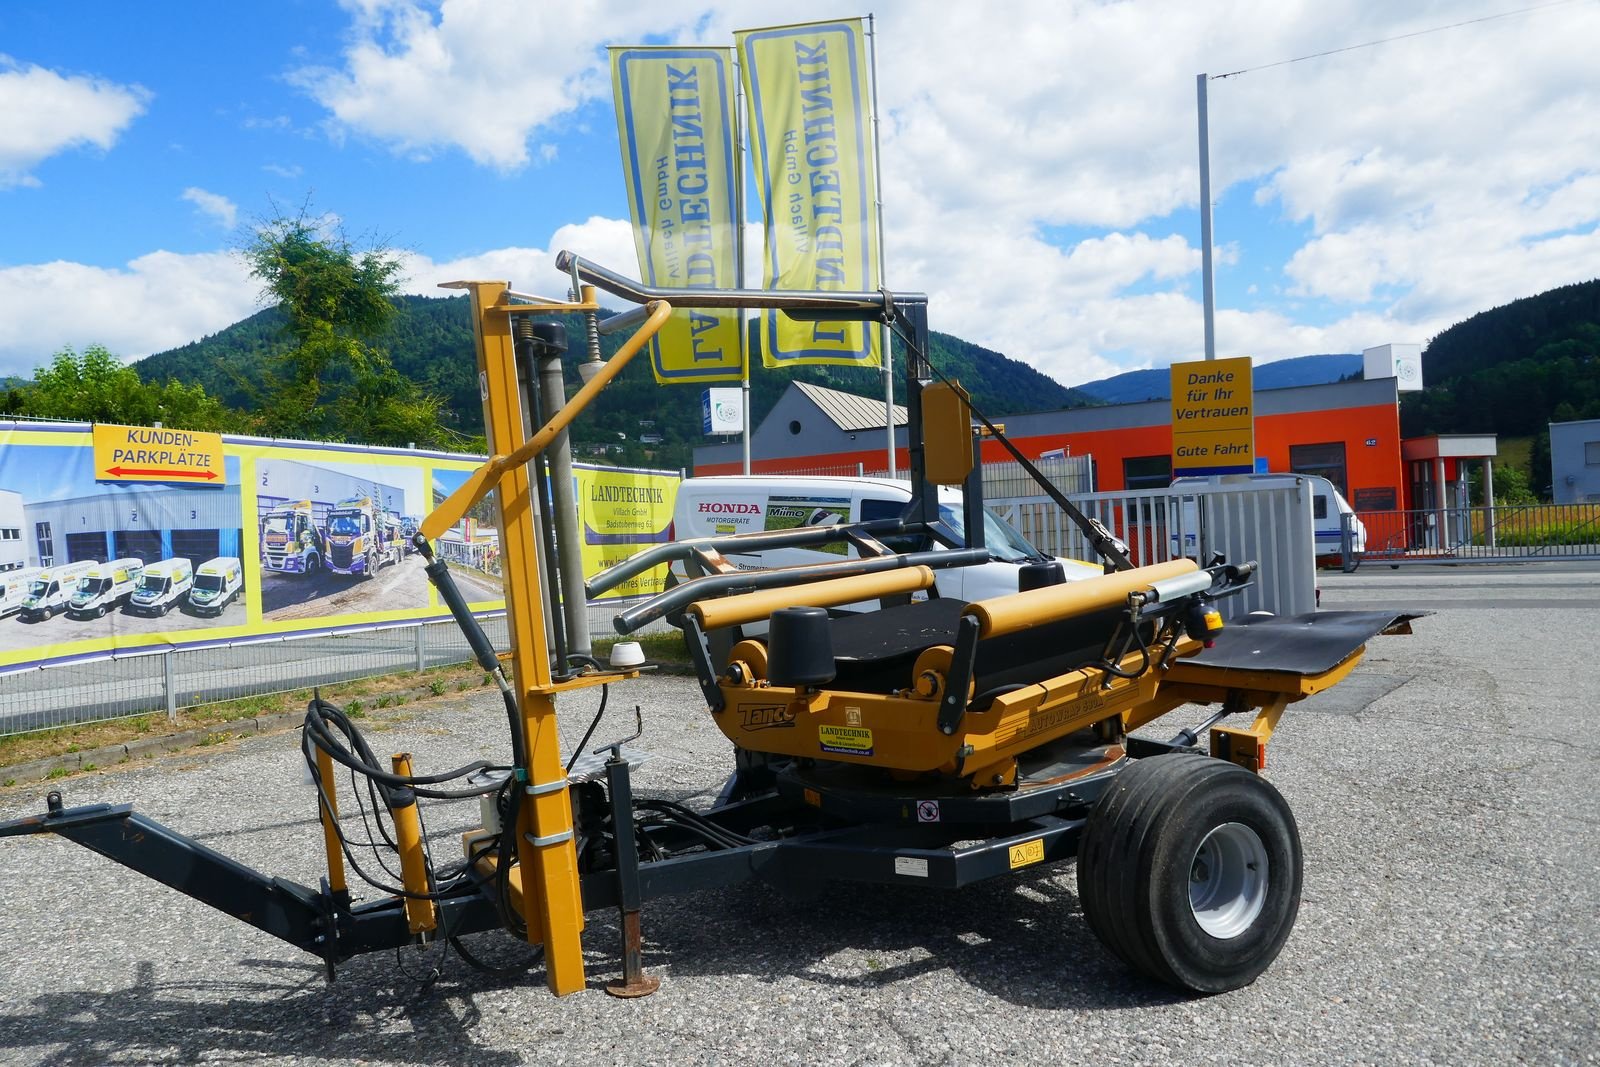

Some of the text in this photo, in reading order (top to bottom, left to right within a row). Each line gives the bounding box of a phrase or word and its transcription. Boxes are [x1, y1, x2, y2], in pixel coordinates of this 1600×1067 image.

[1187, 371, 1234, 385] Danke
[1187, 388, 1234, 402] für Ihr
[1176, 406, 1249, 420] Vertrauen
[127, 429, 199, 447] KUNDEN-
[1176, 443, 1249, 457] Gute Fahrt
[113, 448, 211, 467] PARKPLÄTZE
[591, 485, 664, 504] LANDTECHNIK
[190, 511, 197, 520] 3
[613, 508, 648, 516] Villach GmbH
[698, 503, 761, 514] HONDA
[769, 507, 805, 518] Miimo
[820, 726, 870, 739] LANDTECHNIK
